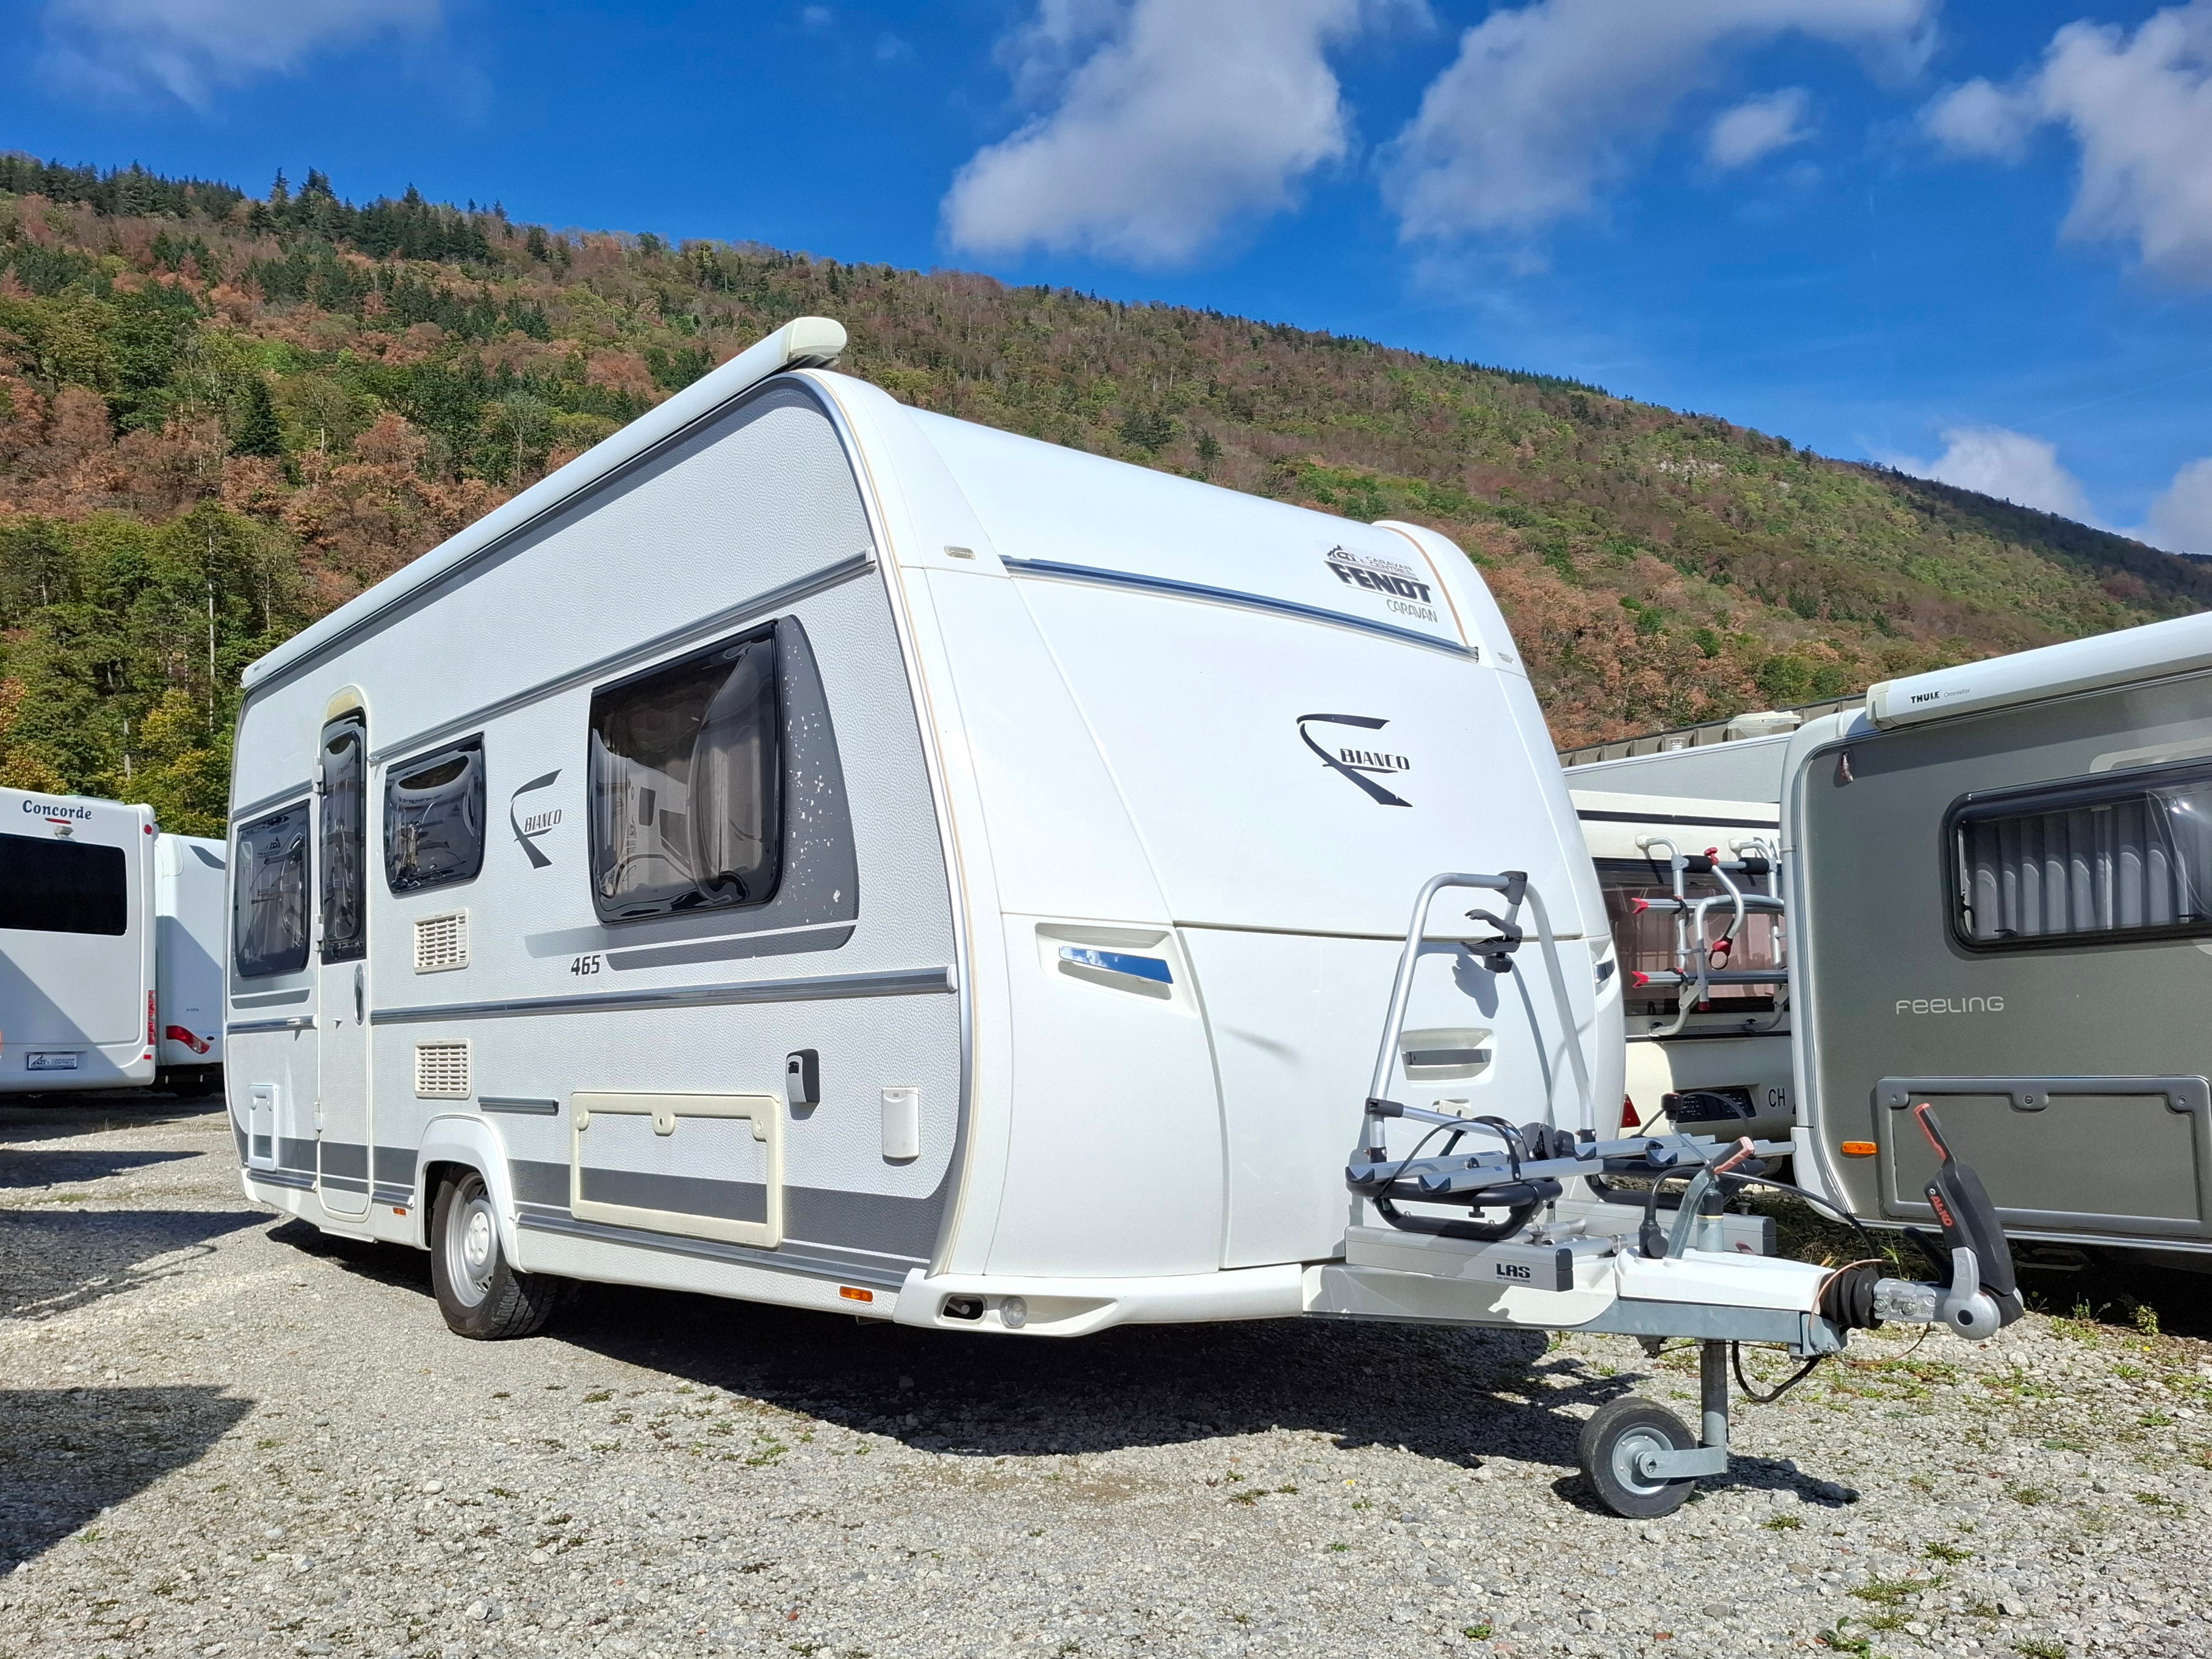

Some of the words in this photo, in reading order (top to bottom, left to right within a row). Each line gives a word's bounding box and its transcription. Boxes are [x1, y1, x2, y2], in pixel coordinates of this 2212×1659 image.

[1365, 556, 1412, 571] CARAVAN
[1323, 560, 1432, 604] FENDT
[1386, 599, 1438, 623] CARAVAN
[1910, 691, 1940, 704] THULE
[1943, 689, 1971, 698] Omnistor
[1340, 748, 1410, 770] BIANCO
[22, 800, 92, 820] Concorde
[524, 809, 562, 833] BIANCO
[571, 954, 601, 976] 465
[1768, 1088, 1786, 1107] CH
[1496, 1263, 1530, 1279] LAS
